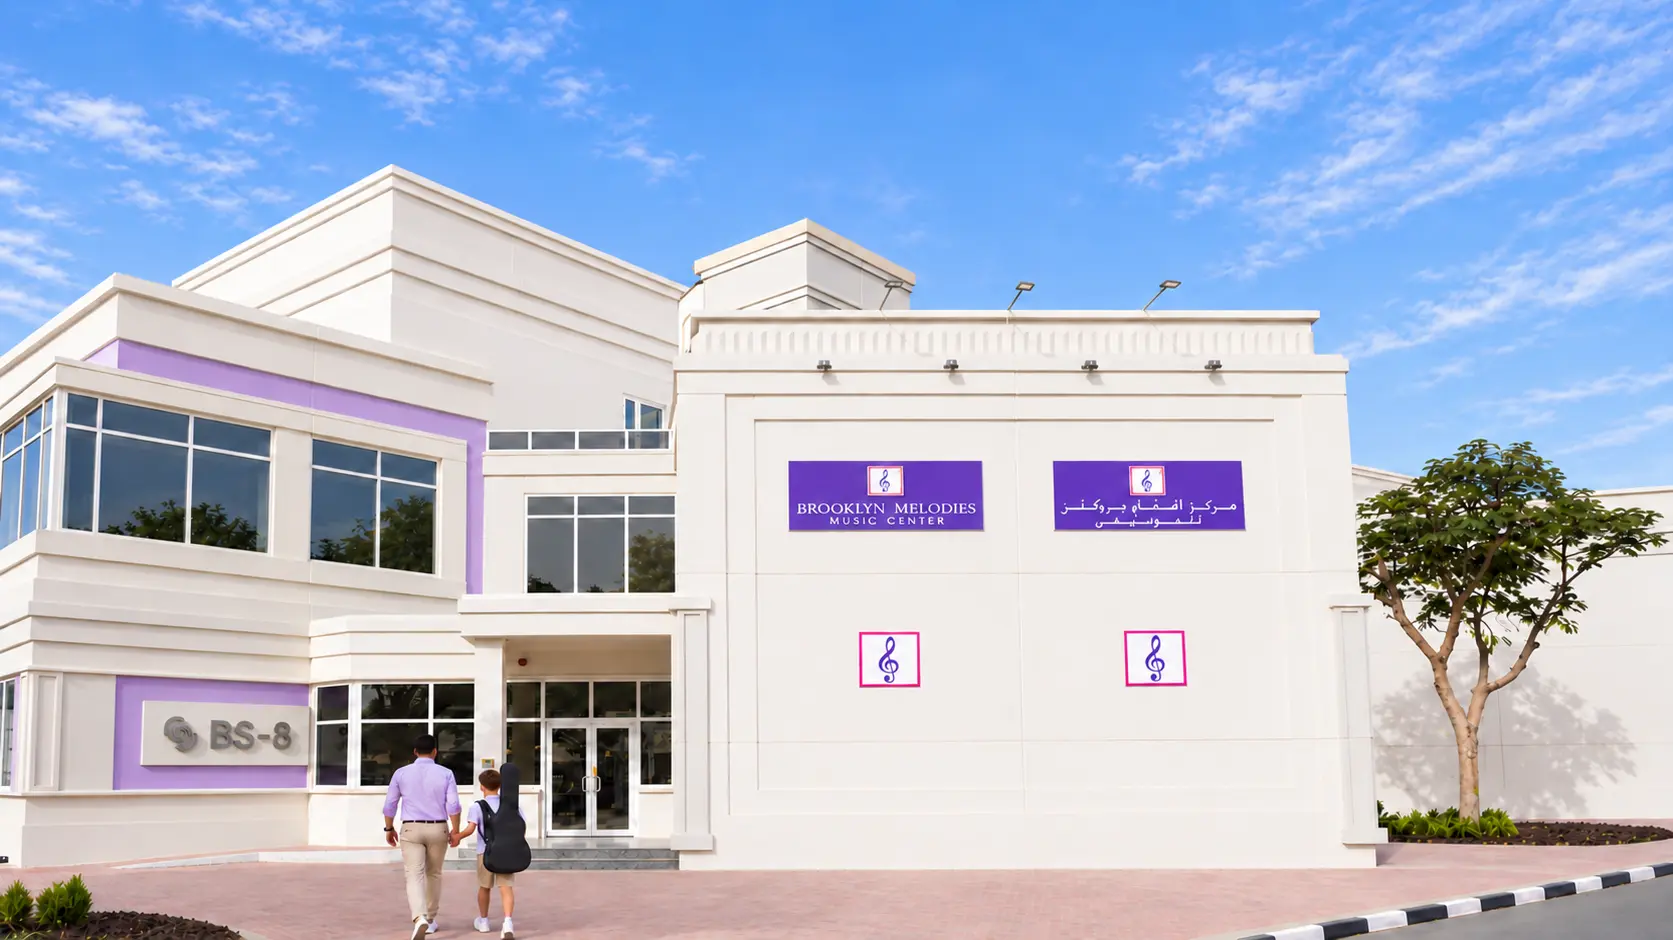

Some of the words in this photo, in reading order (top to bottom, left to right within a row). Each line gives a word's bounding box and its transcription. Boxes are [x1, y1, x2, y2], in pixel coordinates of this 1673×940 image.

[797, 502, 885, 515] BROOKLYN
[894, 502, 977, 515] MELODIES
[1189, 500, 1237, 515] مركز
[829, 516, 877, 525] MUSIC
[886, 516, 945, 525] CENTER
[210, 719, 292, 751] BS-8
